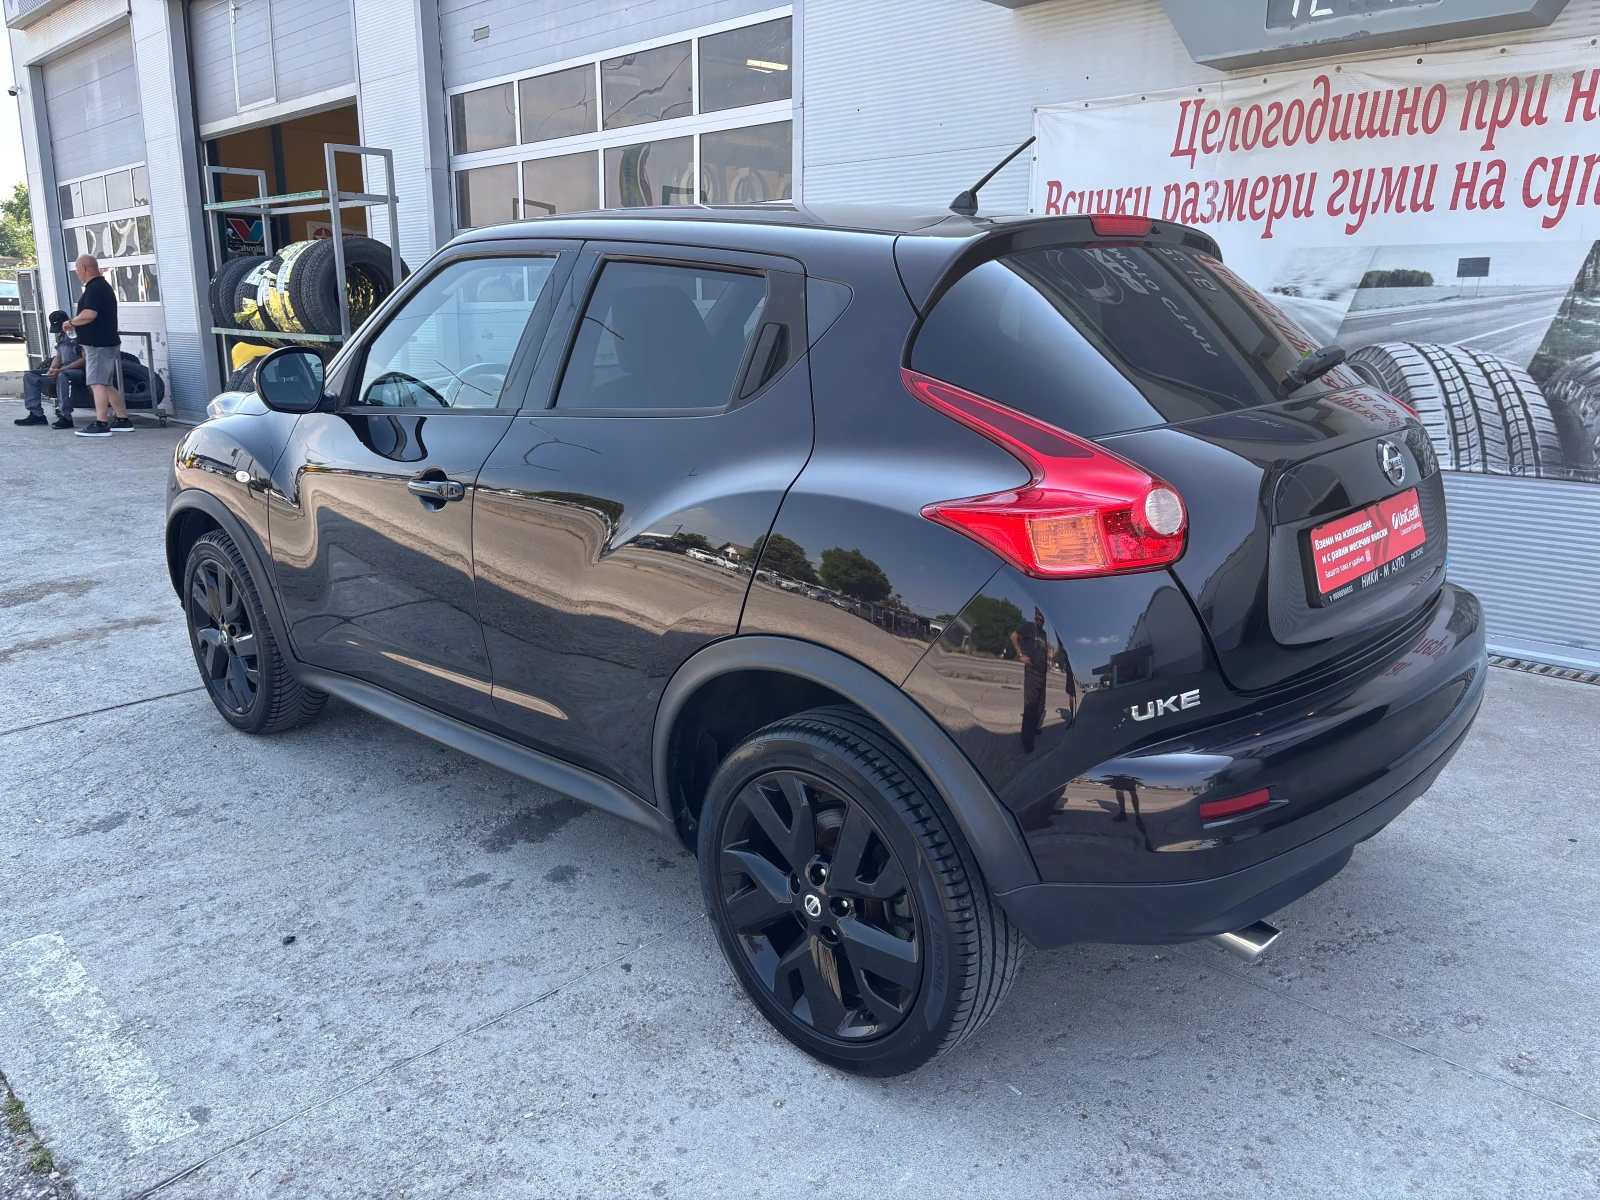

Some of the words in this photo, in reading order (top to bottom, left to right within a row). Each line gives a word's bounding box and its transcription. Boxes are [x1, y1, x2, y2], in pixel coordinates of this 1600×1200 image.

[1170, 75, 1447, 169] Целогодишно
[1459, 74, 1553, 152] при
[1564, 69, 1600, 123] н
[1045, 180, 1151, 215] Всички
[1162, 172, 1318, 239] размери
[1326, 163, 1439, 235] гуми
[1449, 159, 1507, 211] на
[1314, 535, 1335, 551] Вземи
[1334, 532, 1343, 543] на
[1361, 570, 1379, 589] НИКИ
[1122, 689, 1201, 723] UKE
